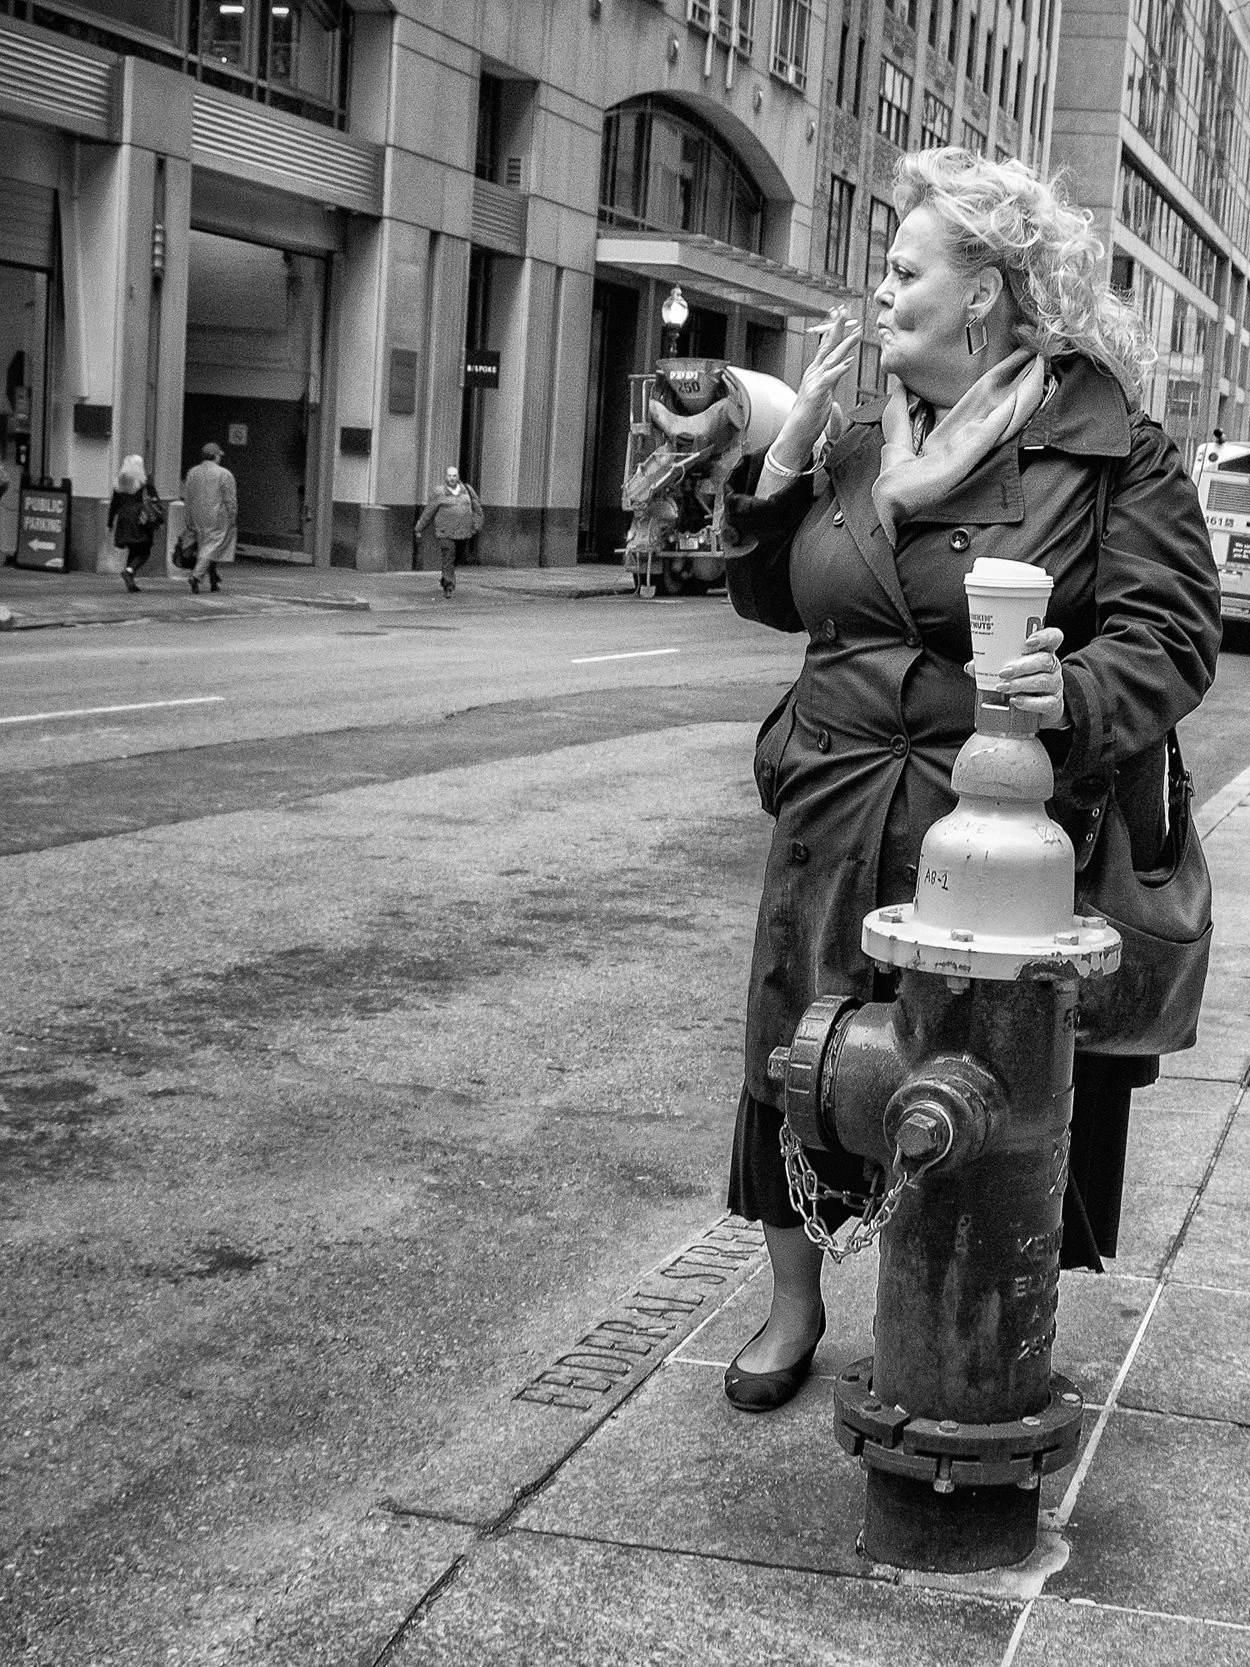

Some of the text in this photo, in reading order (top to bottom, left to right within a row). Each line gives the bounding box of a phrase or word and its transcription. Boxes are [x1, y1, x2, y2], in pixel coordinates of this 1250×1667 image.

[24, 496, 64, 514] PUBLIC
[23, 515, 62, 533] PARKING
[510, 1216, 767, 1413] FEDERAL STREE
